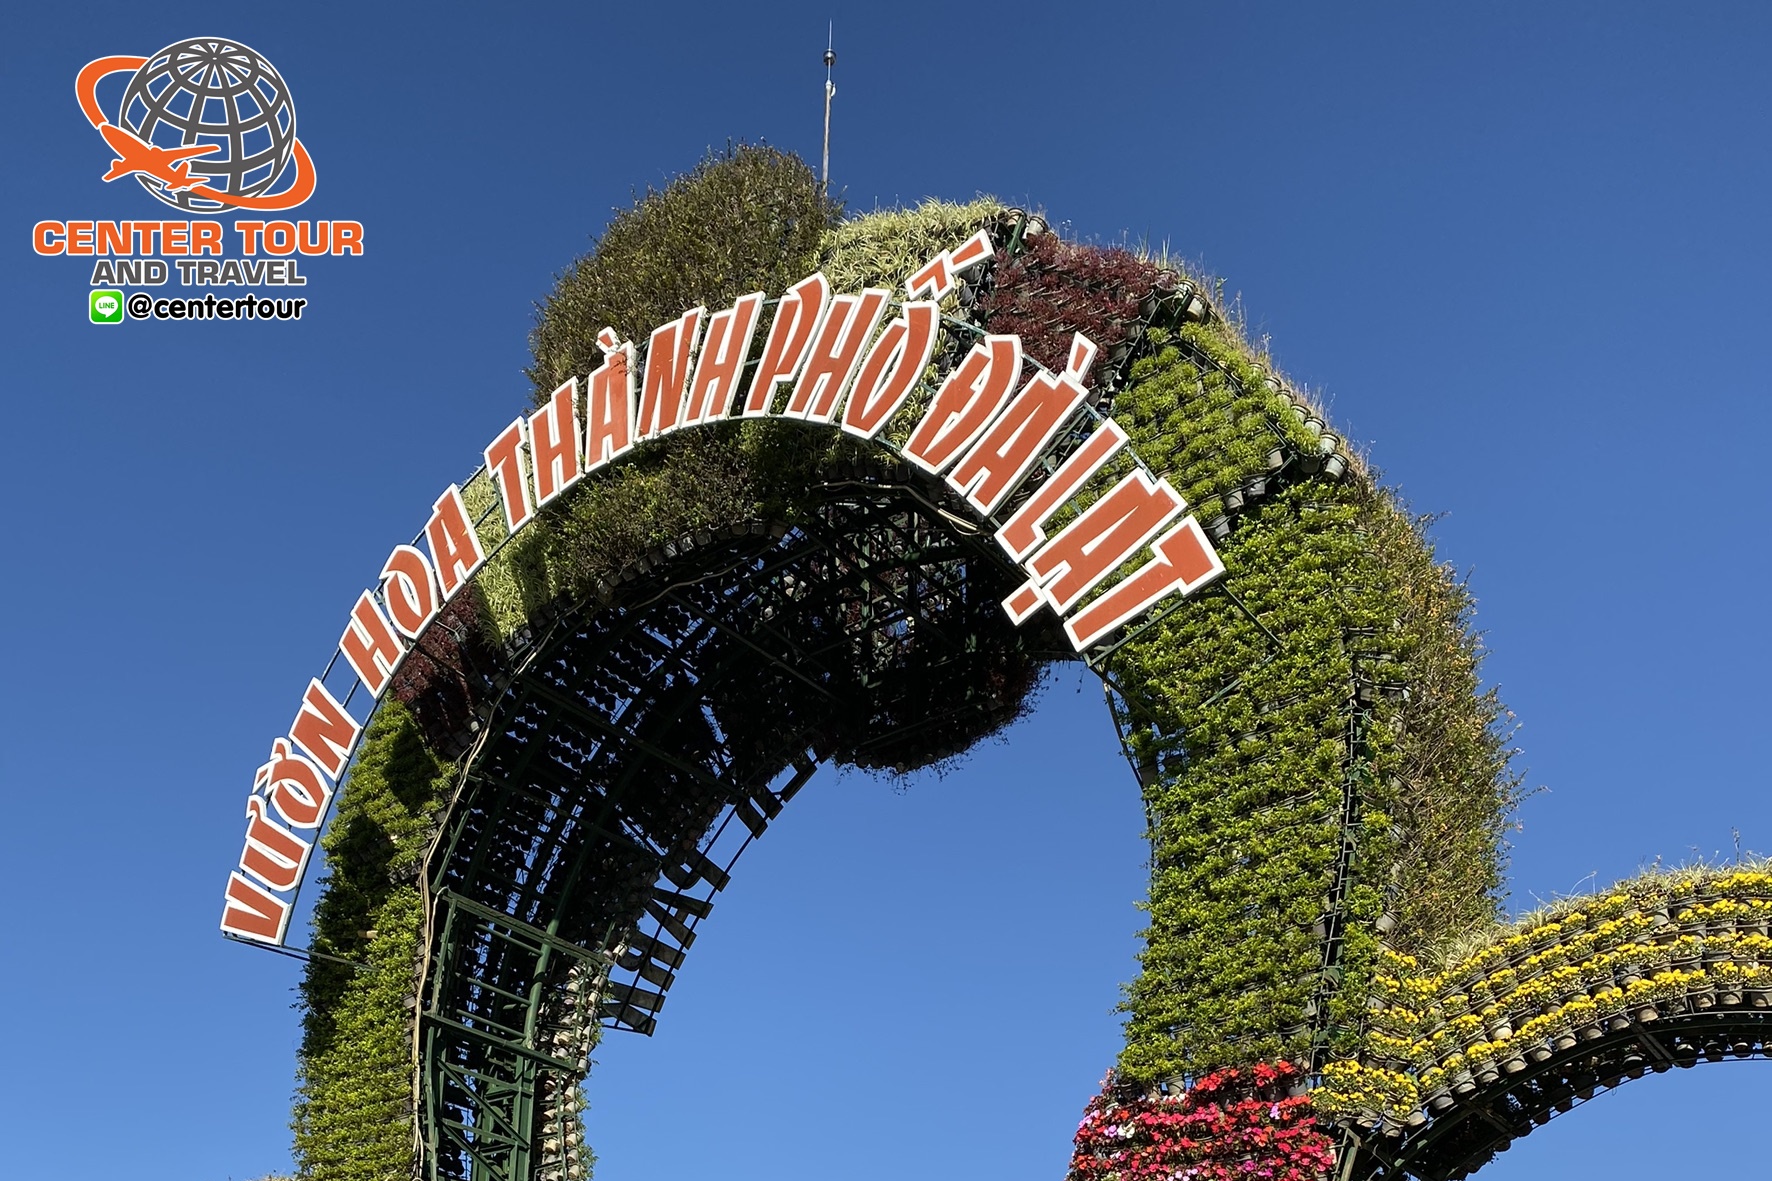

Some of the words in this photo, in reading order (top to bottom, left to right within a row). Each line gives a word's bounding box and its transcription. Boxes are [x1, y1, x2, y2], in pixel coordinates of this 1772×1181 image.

[338, 483, 487, 699] HOA
[483, 290, 765, 535] THÀNH
[743, 229, 995, 440] PHỐ
